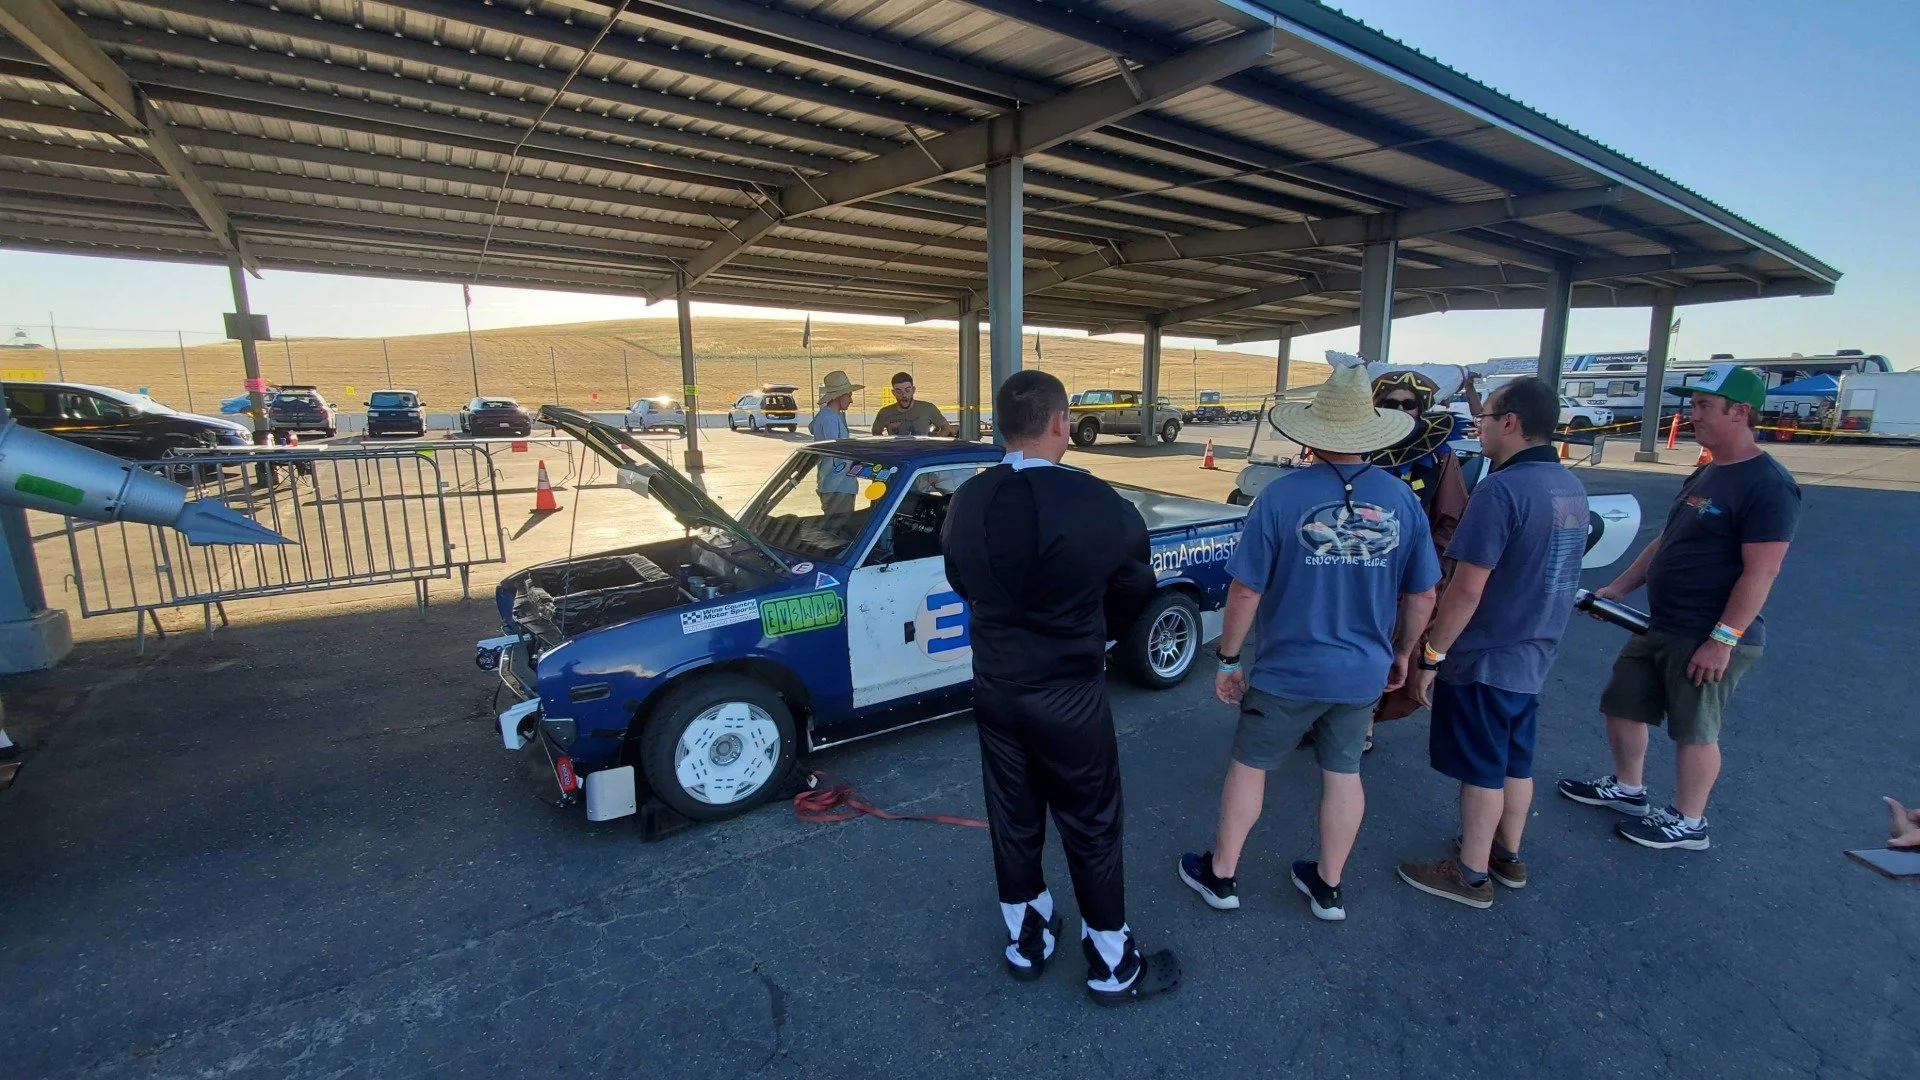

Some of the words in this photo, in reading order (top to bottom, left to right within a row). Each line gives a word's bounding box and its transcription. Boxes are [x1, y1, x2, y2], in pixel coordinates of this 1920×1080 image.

[1150, 537, 1236, 573] amArcblast
[1305, 556, 1339, 566] ENJOY
[1363, 557, 1388, 567] RIDE
[703, 607, 723, 615] Wine
[724, 601, 755, 611] Country
[703, 610, 729, 621] Motor
[730, 605, 757, 616] Sports
